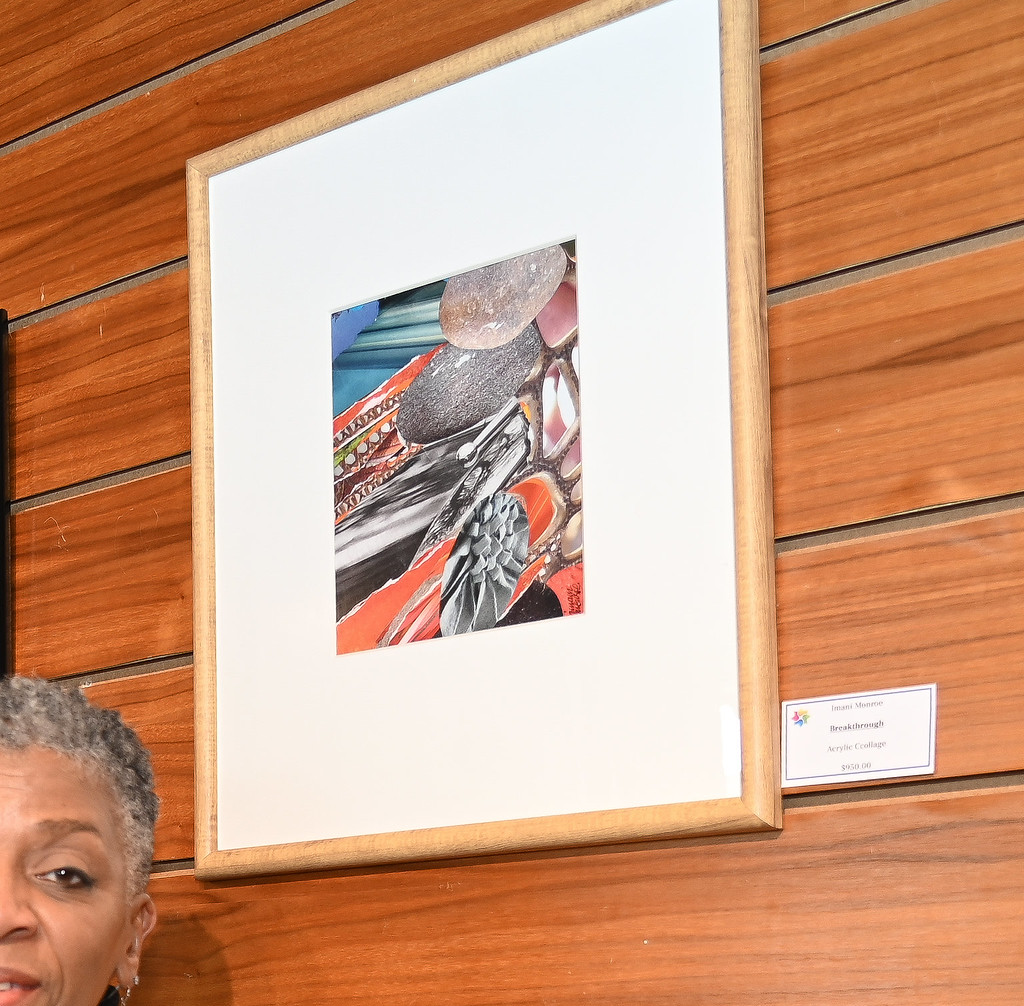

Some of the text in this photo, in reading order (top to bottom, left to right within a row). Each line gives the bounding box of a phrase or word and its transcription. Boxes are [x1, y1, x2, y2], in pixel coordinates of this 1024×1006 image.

[831, 700, 884, 712] Imani Monroe
[829, 720, 884, 732] Breakthrough
[827, 743, 853, 753] Acrylic
[841, 762, 872, 772] $950.00
